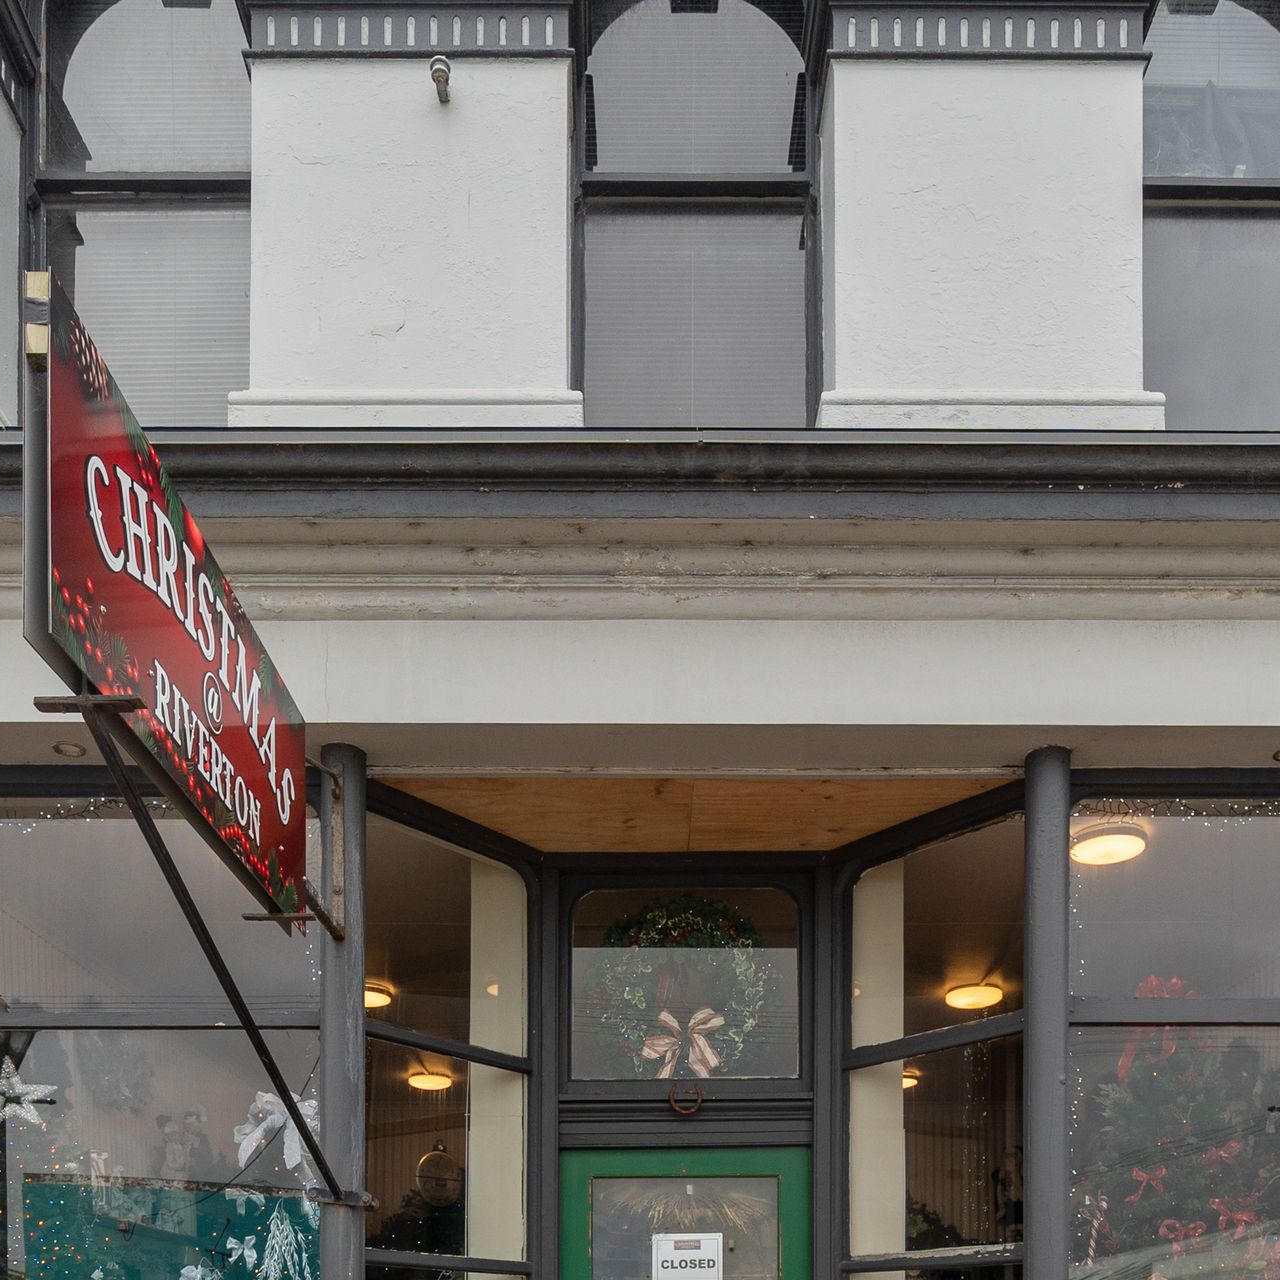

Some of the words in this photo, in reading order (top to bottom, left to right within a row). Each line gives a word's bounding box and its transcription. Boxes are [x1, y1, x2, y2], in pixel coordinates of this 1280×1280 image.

[85, 454, 296, 826] CHRISTMAS
[202, 671, 224, 735] @
[153, 659, 261, 847] RIVERTON
[661, 1258, 717, 1270] CLOSED
